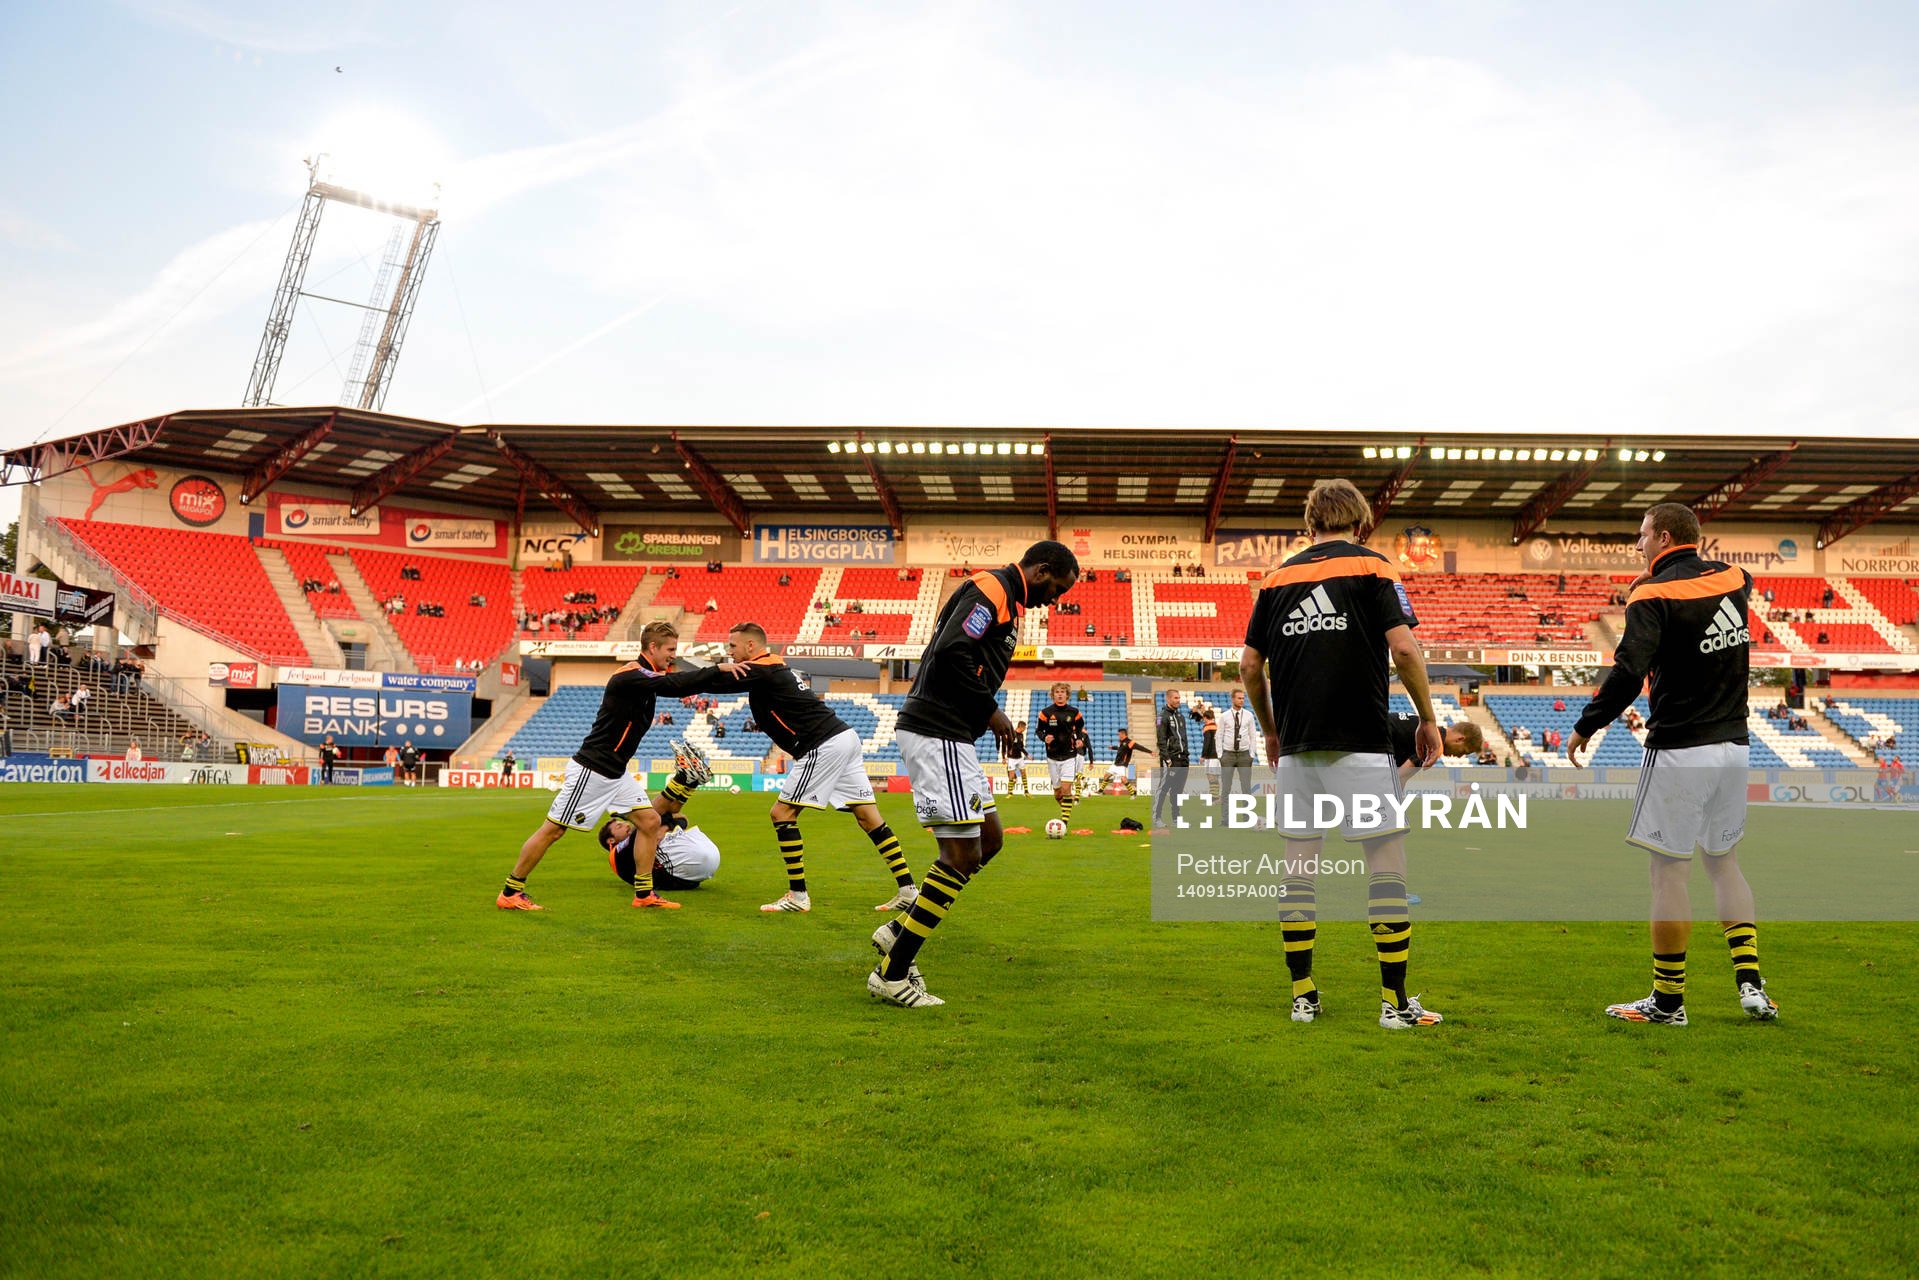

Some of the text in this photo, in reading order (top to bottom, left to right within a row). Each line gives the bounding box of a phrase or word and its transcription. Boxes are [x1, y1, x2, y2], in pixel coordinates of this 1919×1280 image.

[180, 492, 217, 509] mix
[312, 516, 340, 526] smart
[434, 530, 489, 542] smart safety
[643, 533, 721, 545] SPARBANKEN
[760, 527, 888, 560] HELSINGBORGS
[1121, 534, 1178, 545] OLYMPIA
[524, 539, 572, 553] NCC
[788, 540, 887, 560] BYGGPLÅT
[1700, 536, 1784, 570] Kinnarps
[0, 572, 40, 600] MAXI
[1282, 612, 1348, 637] adidas
[786, 646, 854, 656] OPTIMERA
[1512, 651, 1597, 663] DIN-X BENSIN
[231, 669, 255, 680] mix
[388, 675, 473, 690] water company
[305, 695, 449, 720] RESURS
[304, 717, 387, 736] BANK
[260, 768, 286, 785] PUMA
